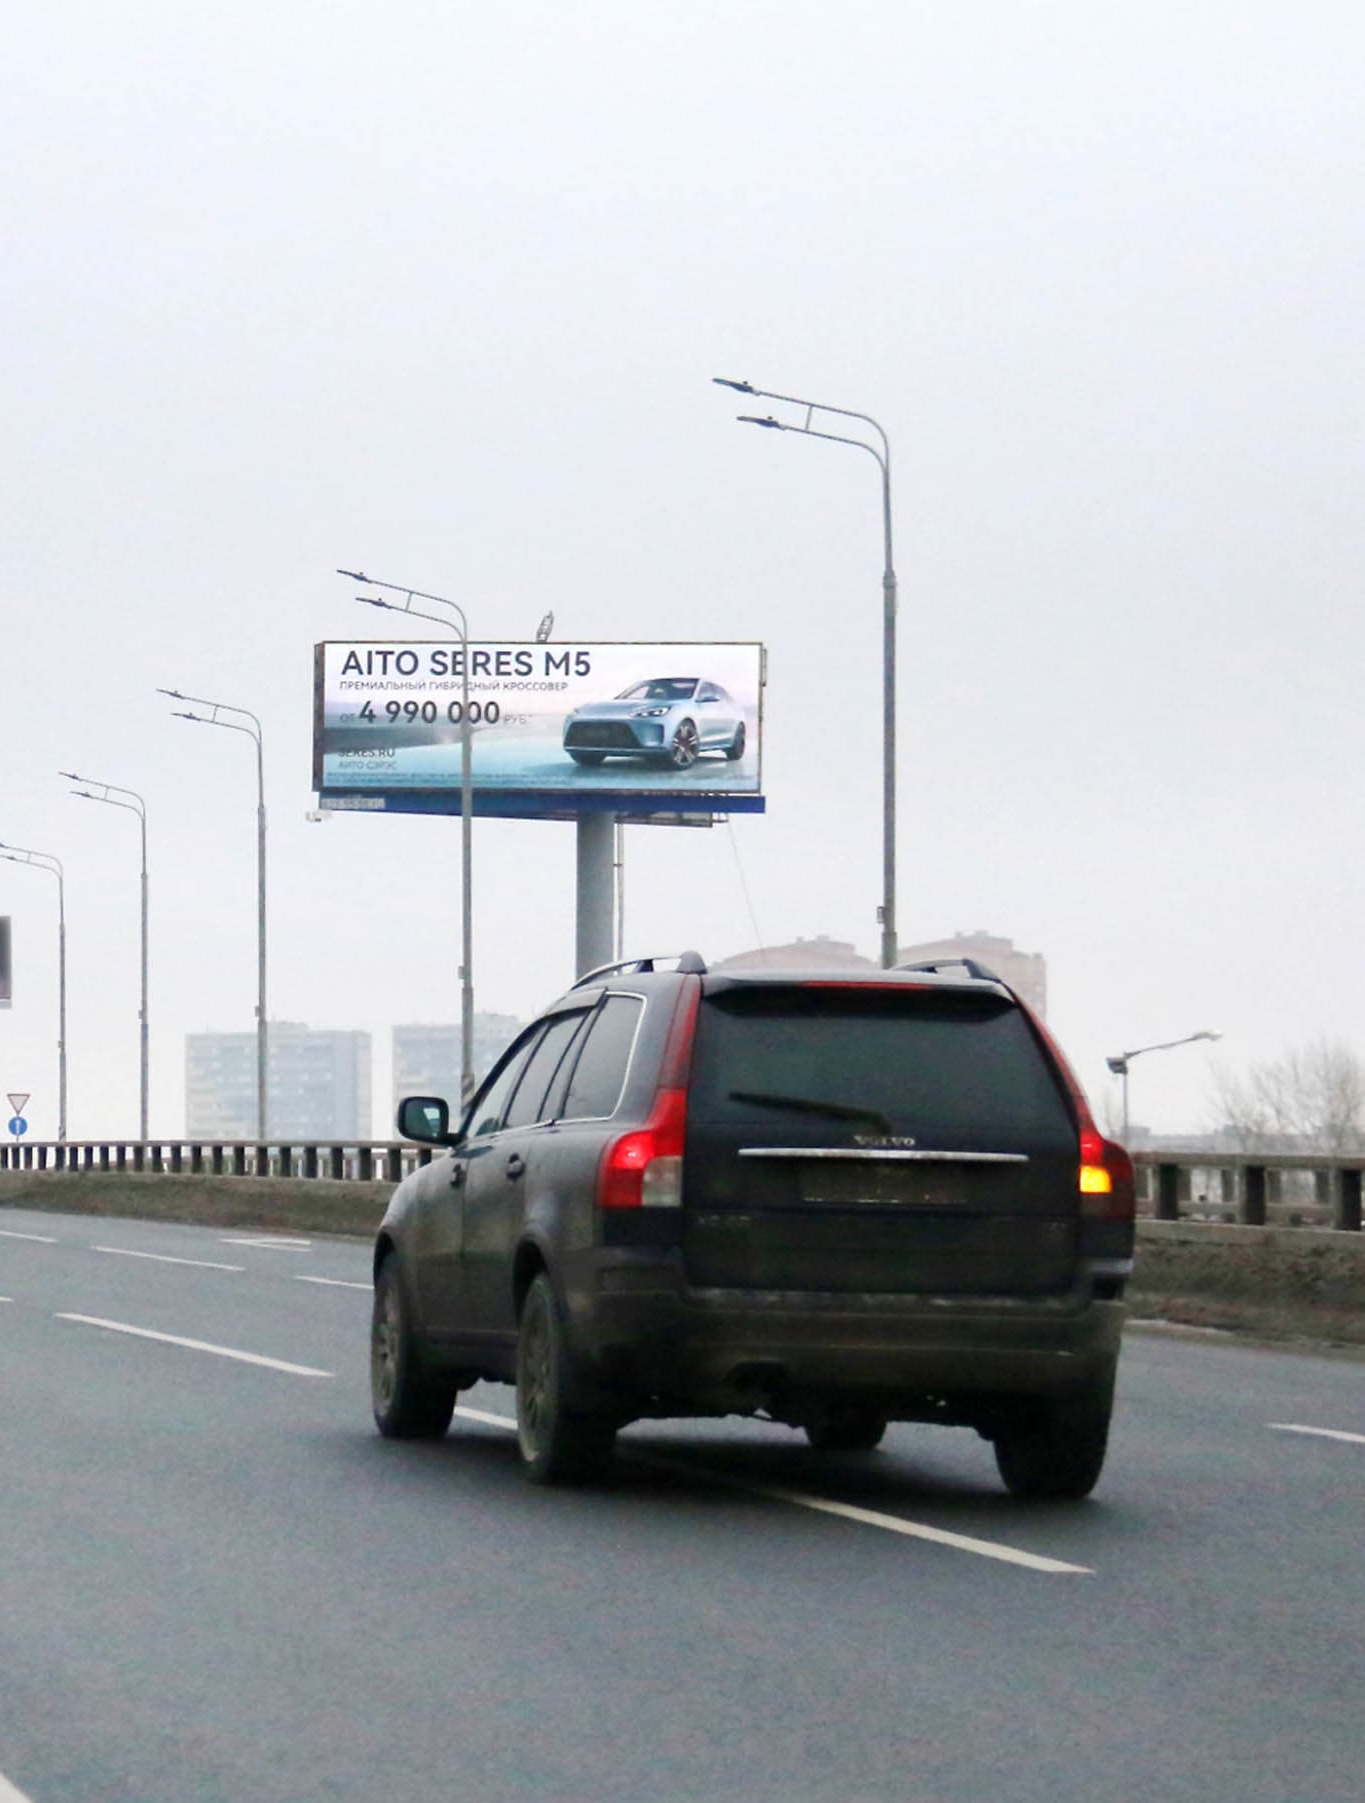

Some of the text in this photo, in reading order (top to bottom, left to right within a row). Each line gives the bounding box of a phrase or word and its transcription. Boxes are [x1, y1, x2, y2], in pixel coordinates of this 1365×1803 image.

[341, 650, 591, 677] AITO SERES M5
[339, 680, 426, 691] ПРЕМИАЛЬНЫЙ
[503, 681, 569, 692] КРОССОВЕР
[359, 700, 377, 724] 4
[385, 700, 438, 724] 990
[447, 701, 501, 725] 000
